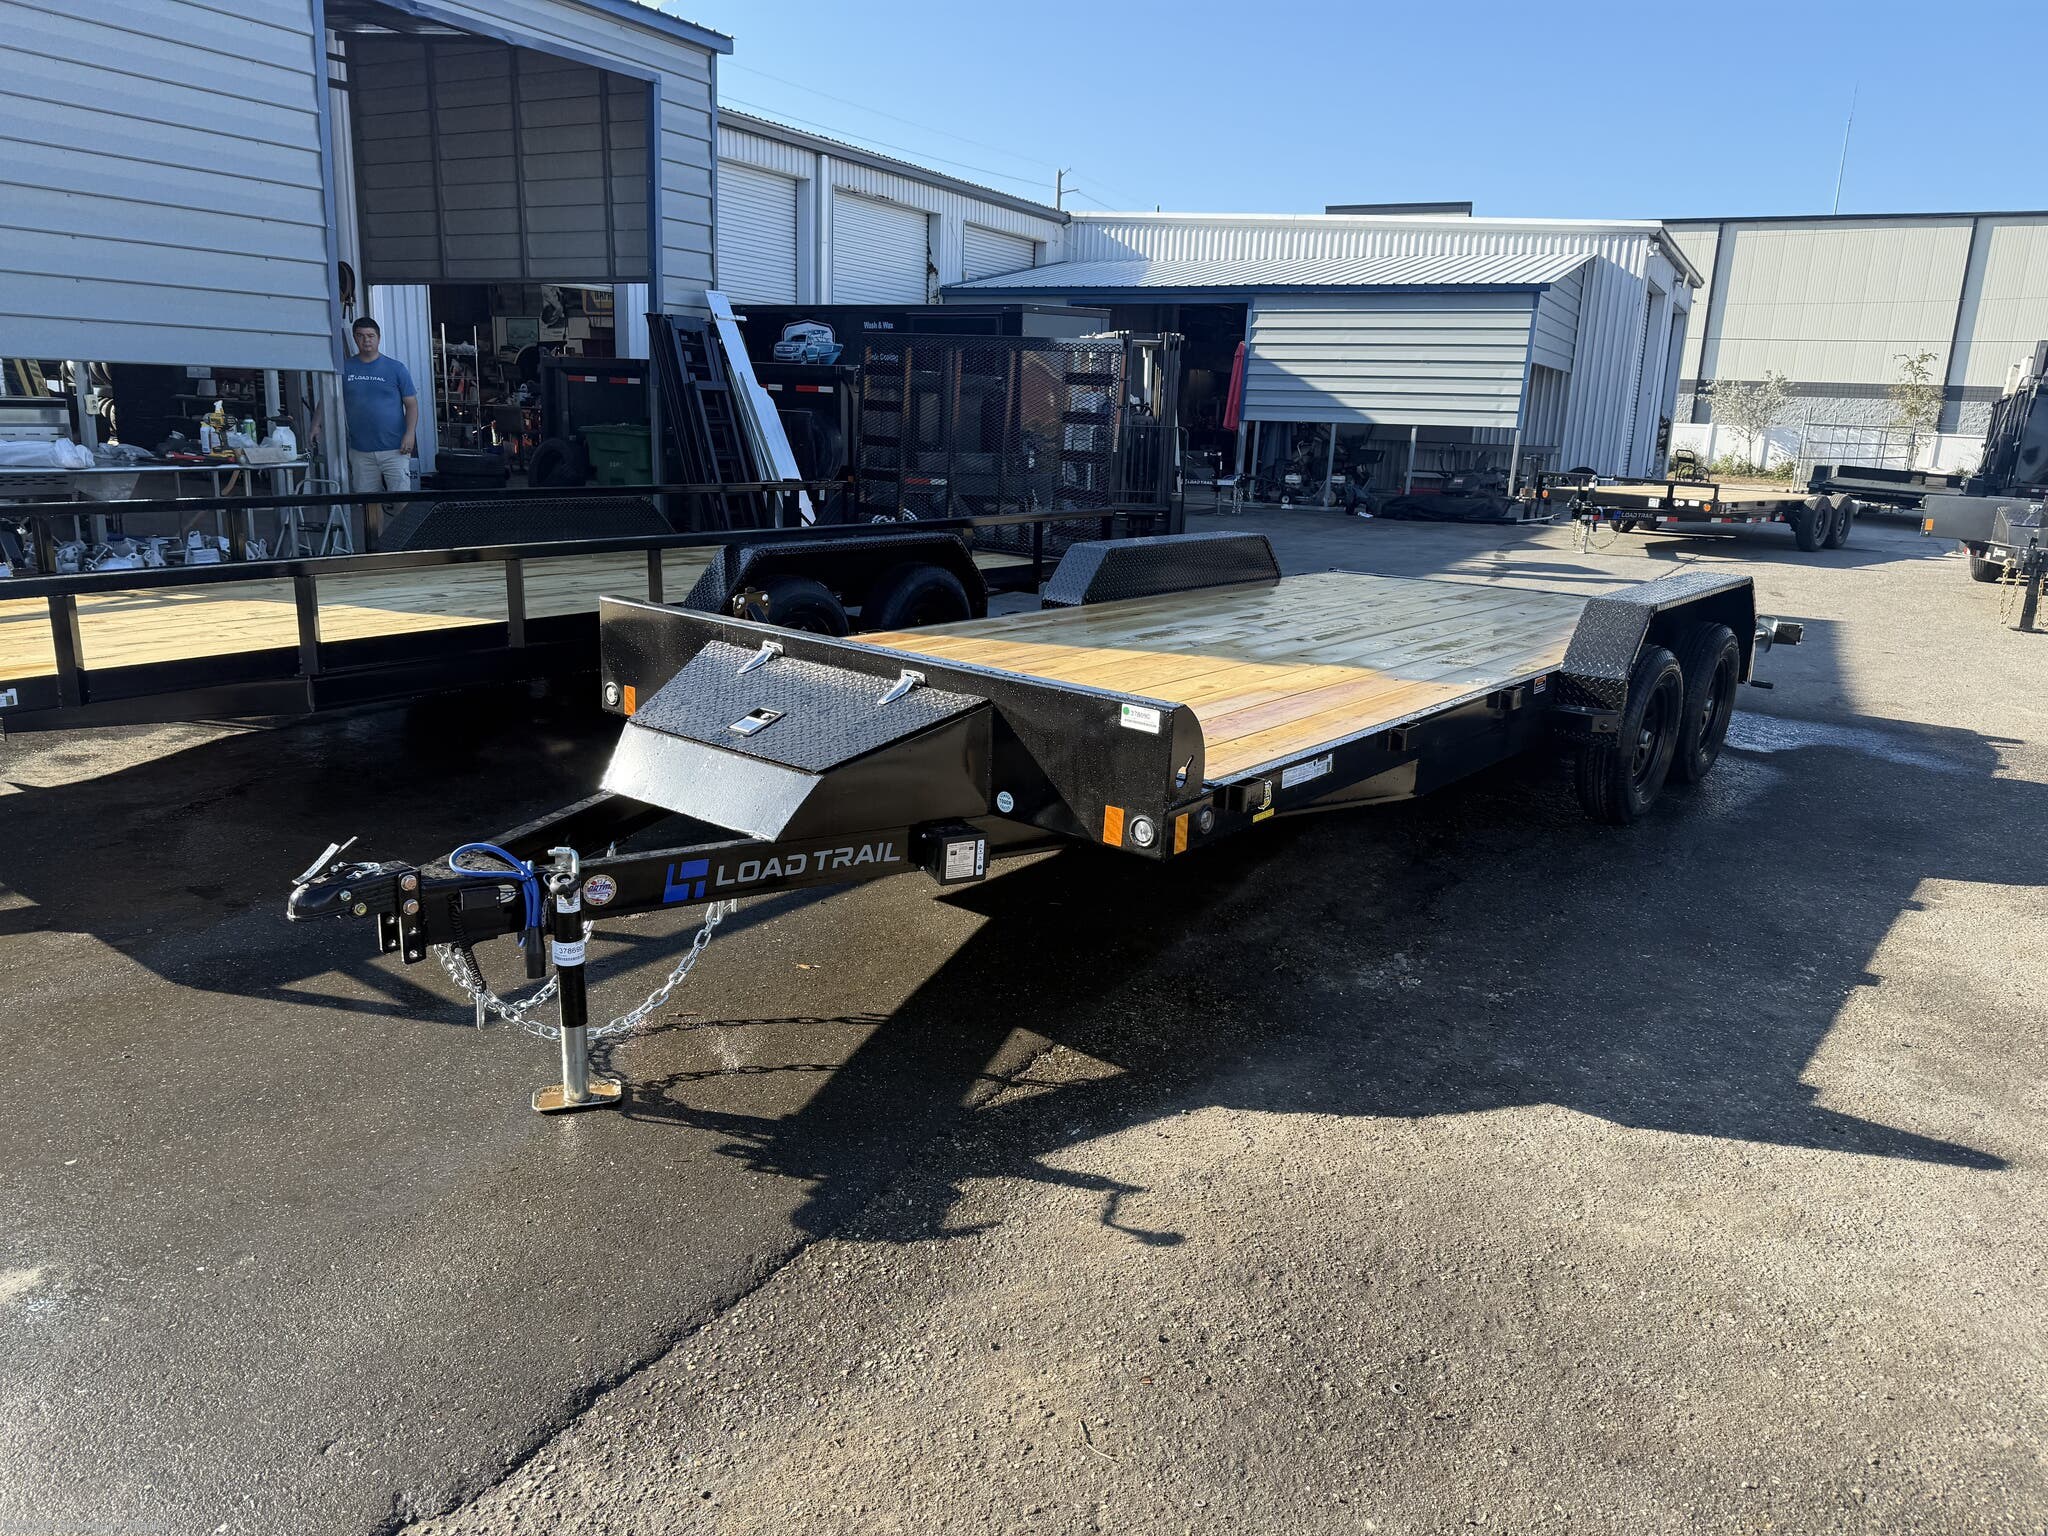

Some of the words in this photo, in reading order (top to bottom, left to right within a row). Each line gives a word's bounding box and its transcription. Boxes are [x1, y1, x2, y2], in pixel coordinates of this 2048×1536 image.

[863, 321, 878, 329] Wash
[882, 321, 894, 329] Wax
[715, 853, 807, 887] LOAD
[814, 842, 901, 871] TRAIL
[558, 945, 583, 955] 378690
